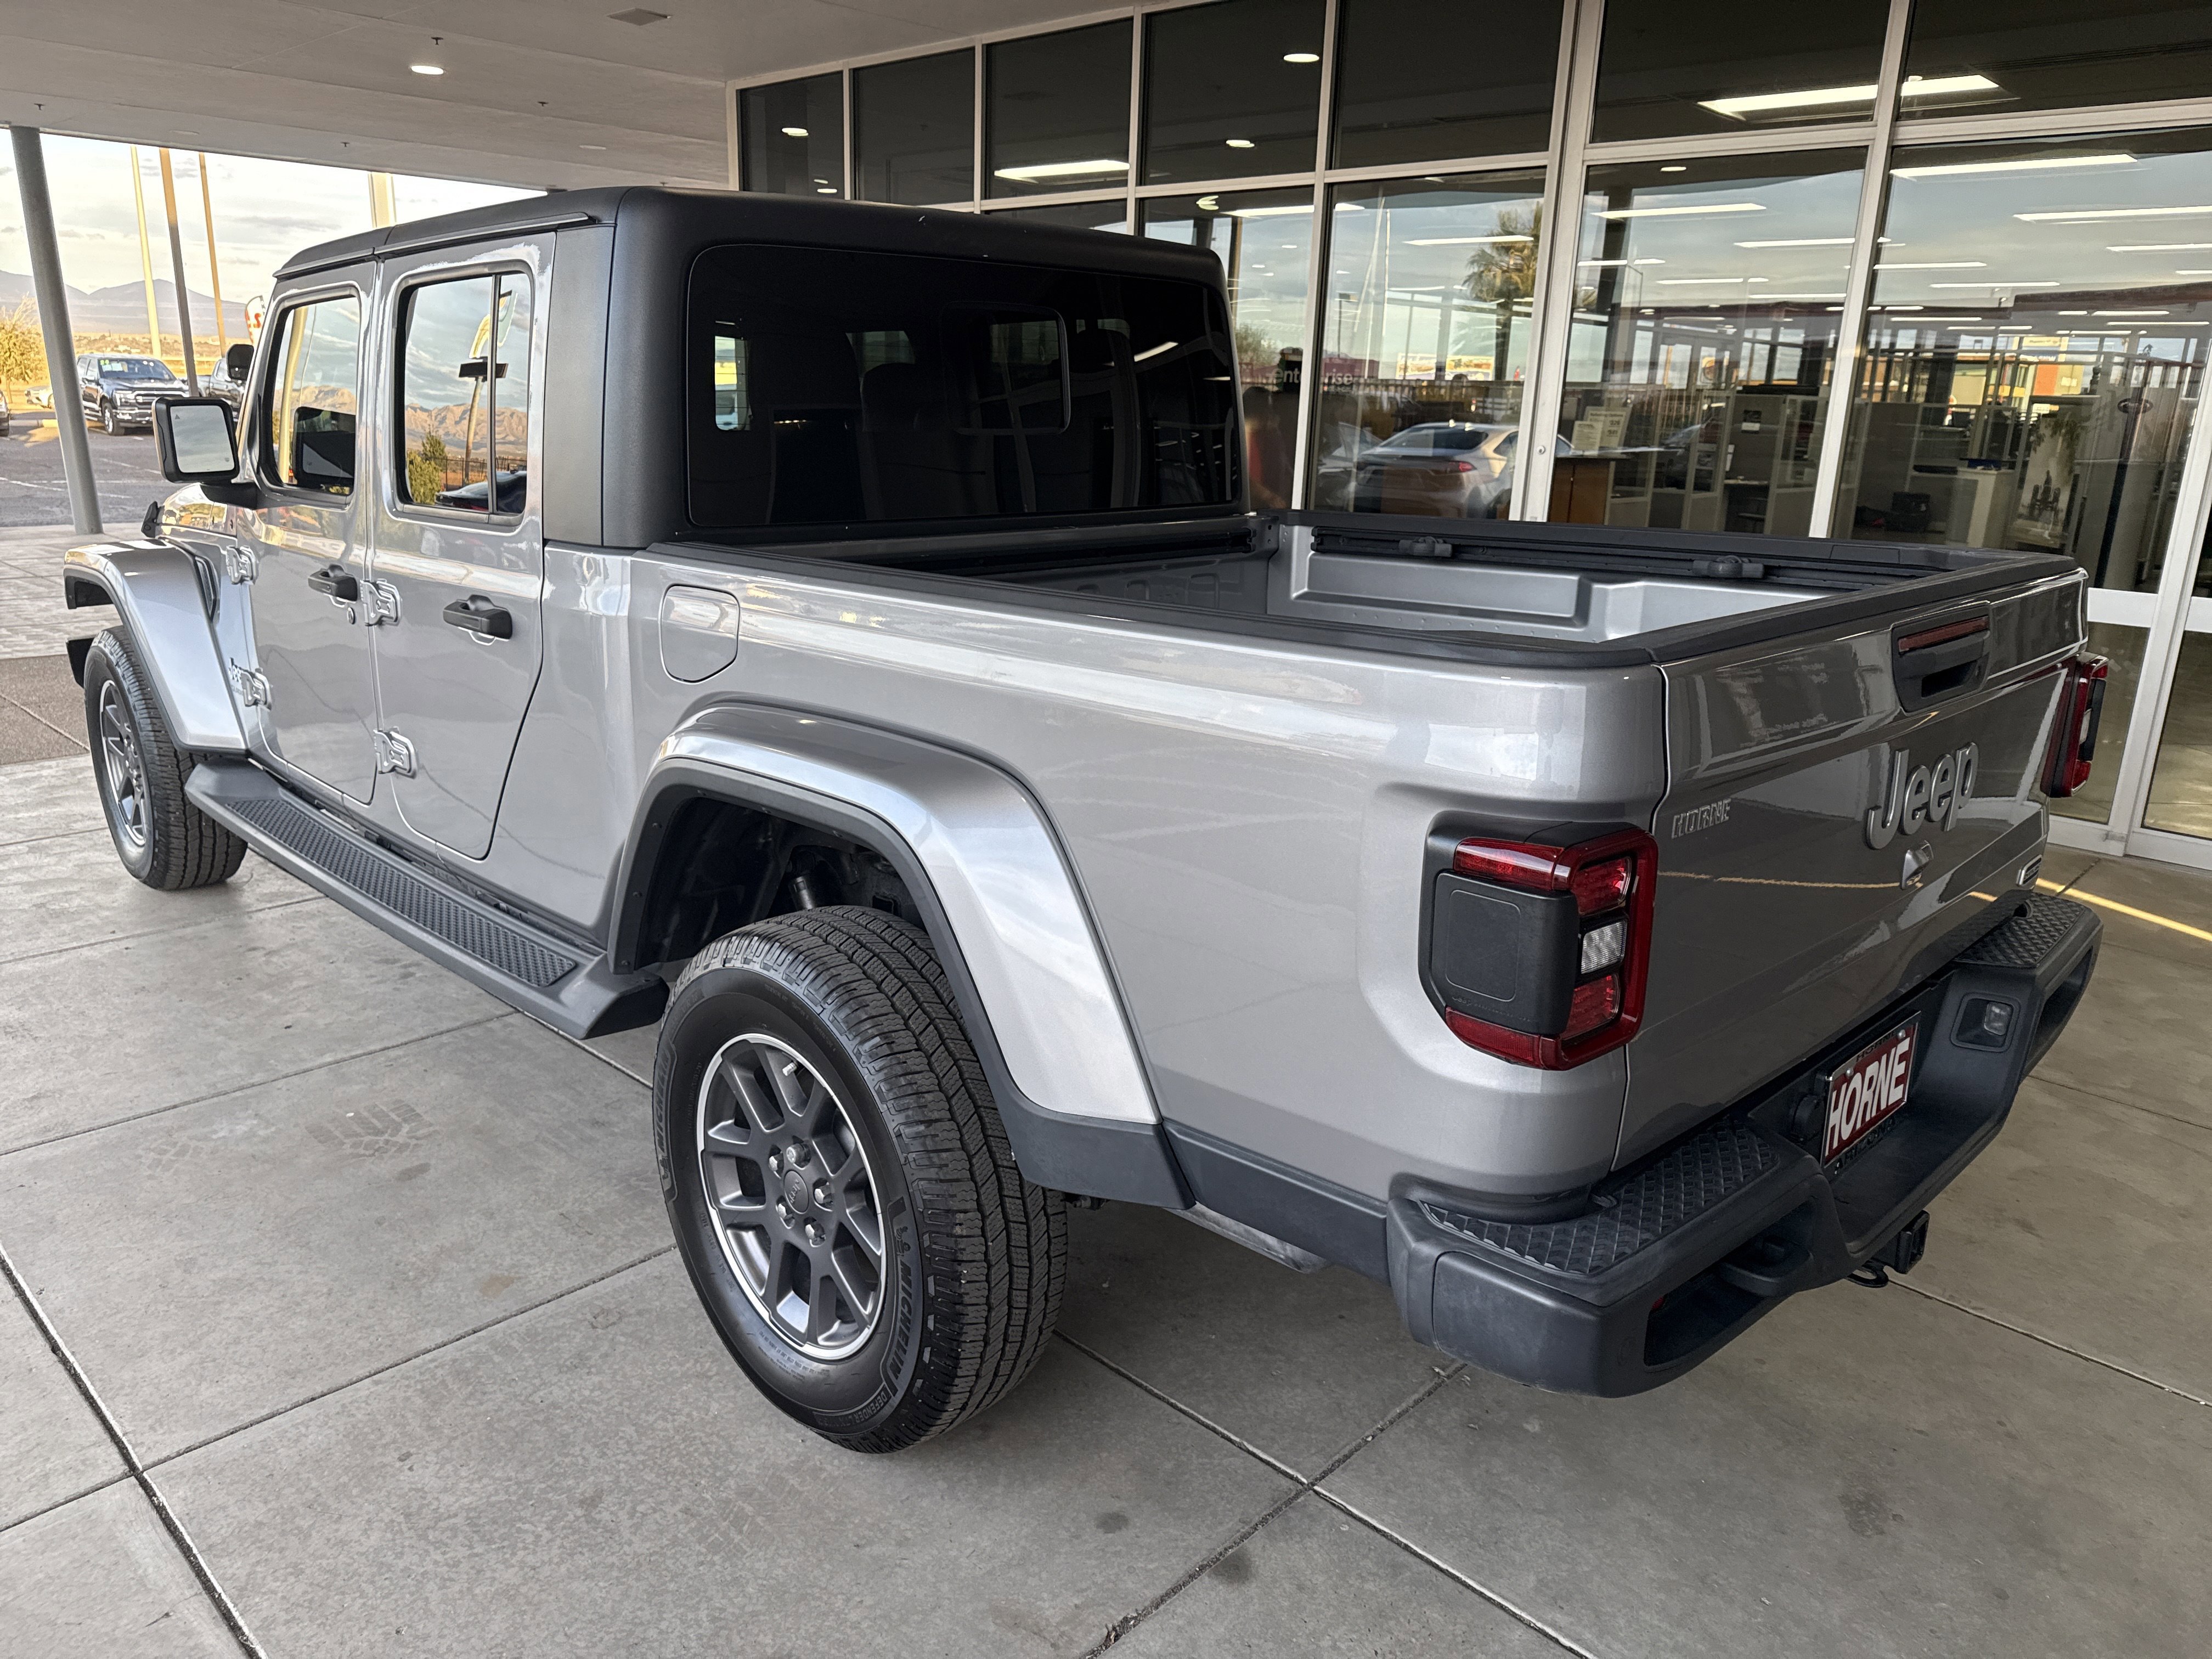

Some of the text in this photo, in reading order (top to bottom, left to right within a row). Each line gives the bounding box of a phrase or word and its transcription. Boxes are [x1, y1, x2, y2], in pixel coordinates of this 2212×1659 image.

[1671, 798, 1731, 838] HORNE
[1866, 742, 1979, 849] Jeep
[1825, 1037, 1910, 1157] HORNE
[889, 1260, 912, 1380] MICHELIN
[854, 1391, 887, 1423] DEFENDER
